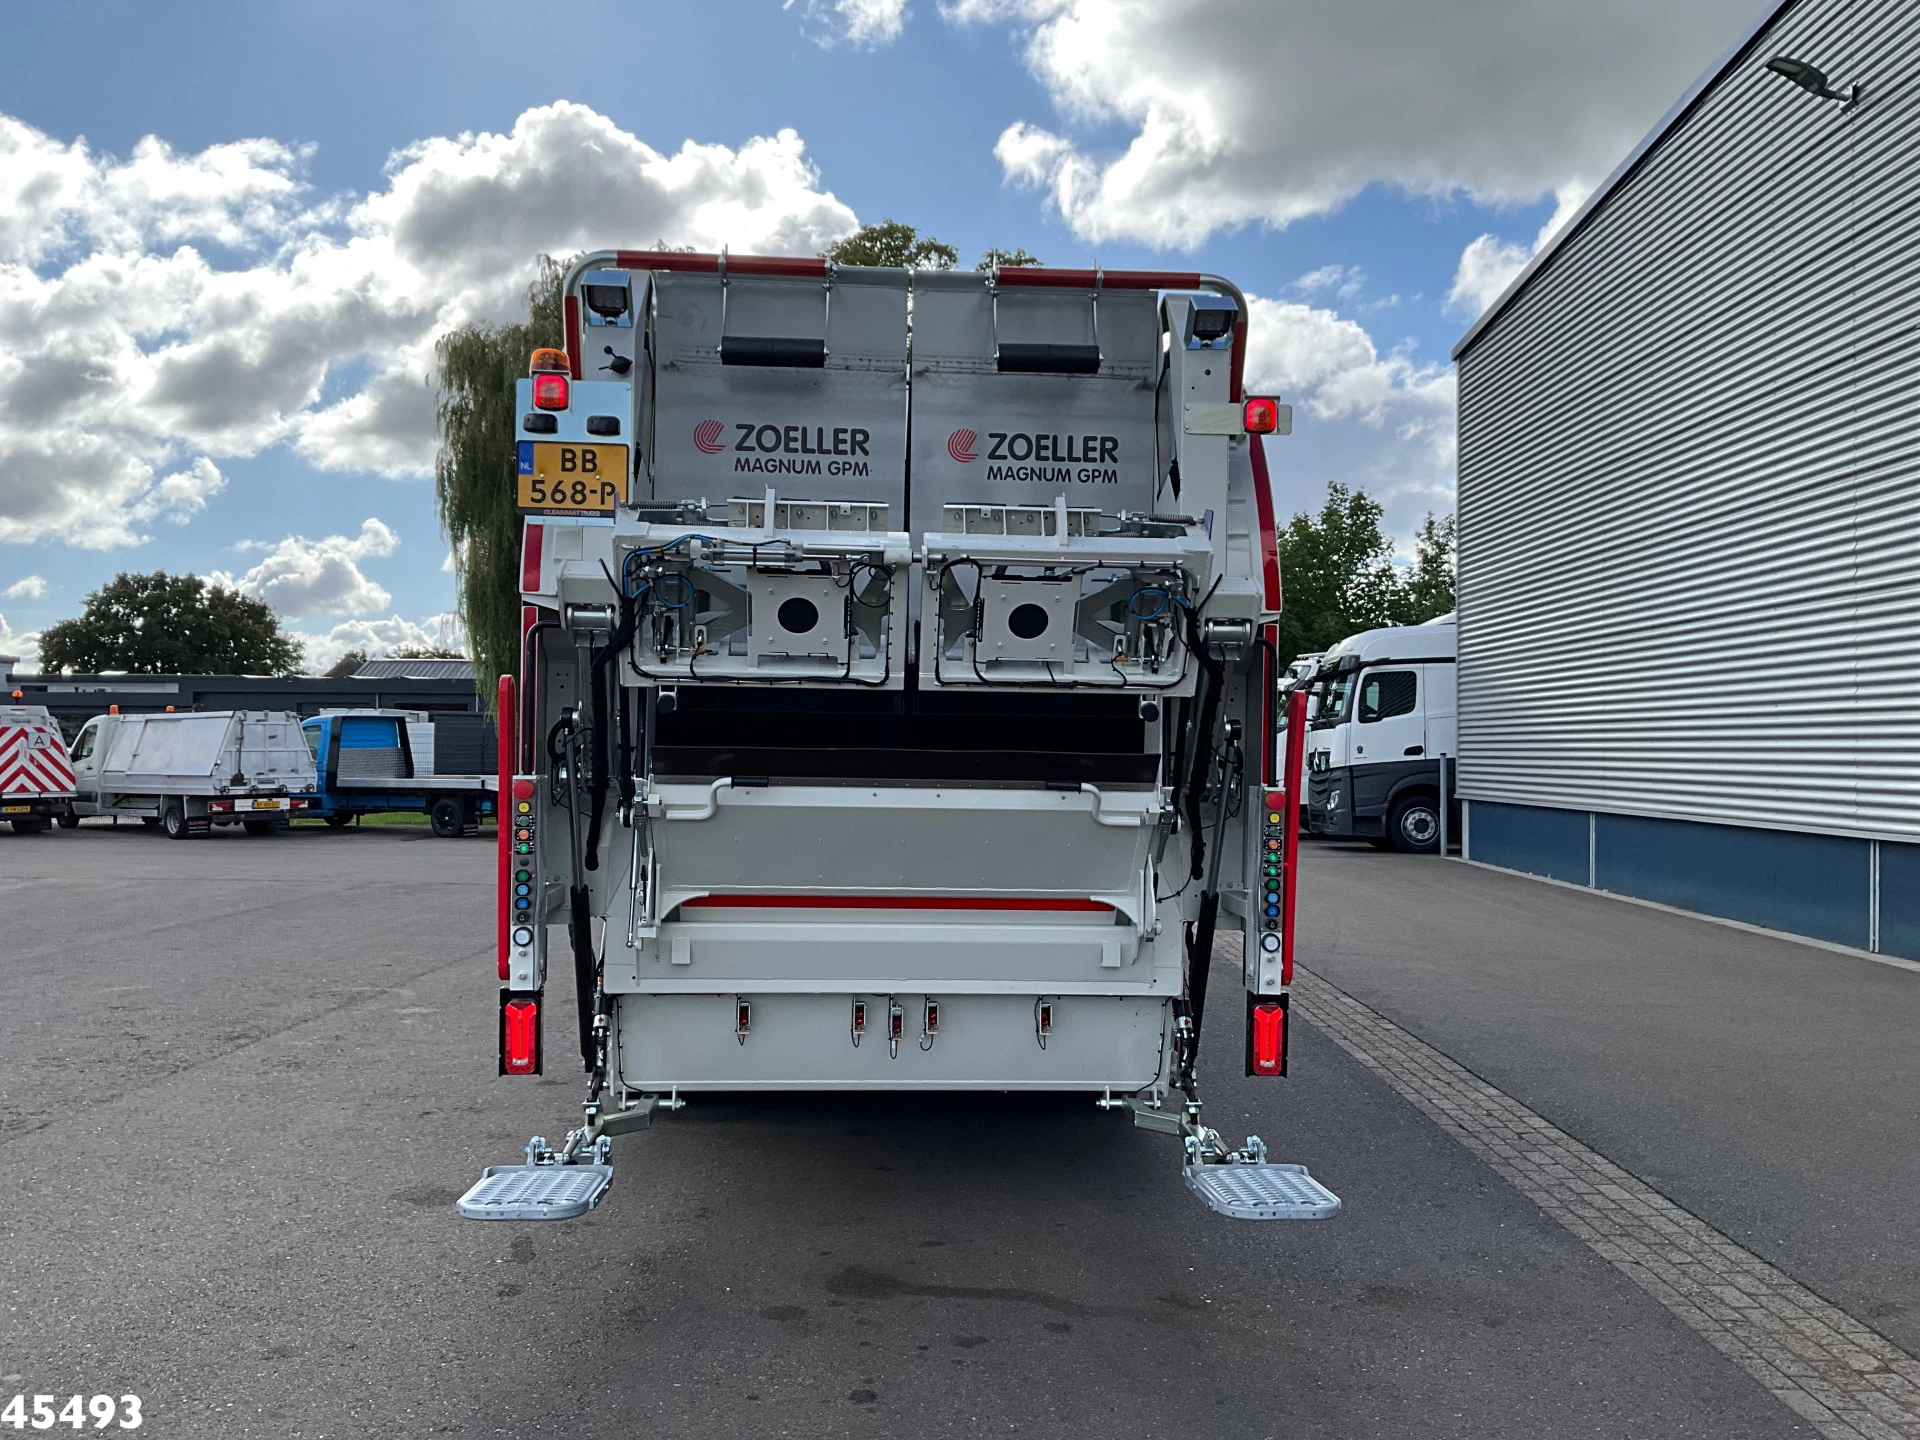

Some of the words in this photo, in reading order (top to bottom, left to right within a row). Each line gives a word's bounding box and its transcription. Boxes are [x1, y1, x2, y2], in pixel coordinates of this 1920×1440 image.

[734, 424, 870, 456] ZOELLER
[987, 433, 1119, 464] ZOELLER
[520, 461, 532, 470] NL
[561, 448, 598, 473] BB
[734, 457, 822, 475] MAGNUM
[827, 461, 869, 477] GPM
[987, 466, 1072, 482] MAGNUM
[1077, 468, 1118, 484] GPM
[530, 479, 616, 506] 568-P
[34, 736, 45, 746] A
